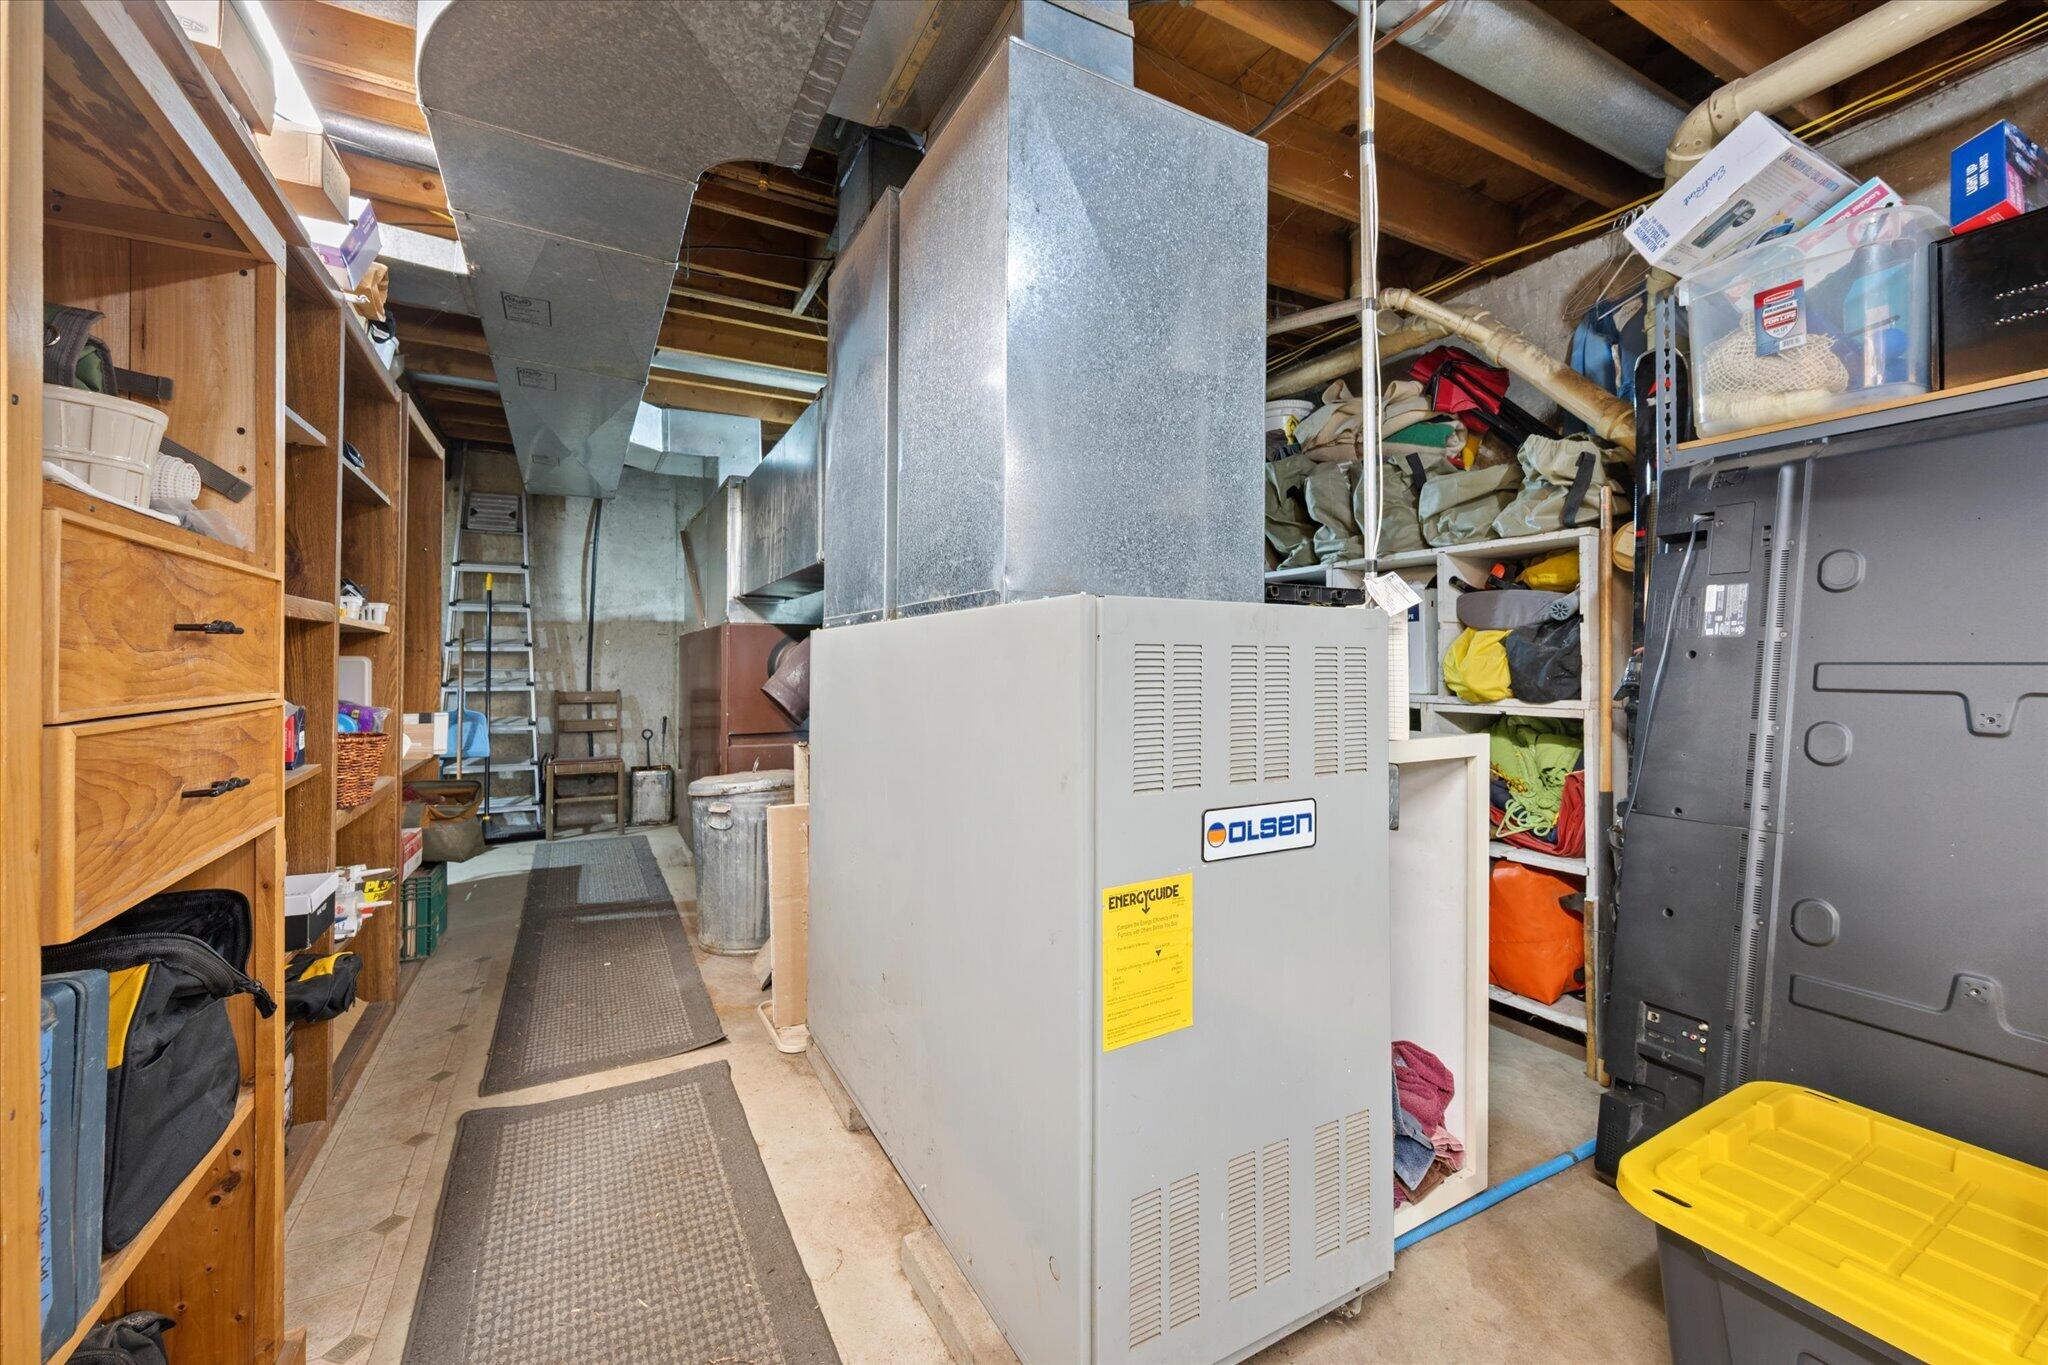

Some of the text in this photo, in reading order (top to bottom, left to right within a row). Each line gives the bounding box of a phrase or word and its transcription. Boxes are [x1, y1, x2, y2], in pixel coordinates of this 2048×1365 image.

[1966, 163, 1978, 196] LIGHT UP
[1979, 153, 1989, 189] LAWN DARTS
[1852, 190, 1881, 213] Ladder
[1634, 226, 1658, 253] BADMINTON
[1640, 217, 1663, 245] VOLLEYBALL
[1228, 812, 1313, 843] OLSEN
[364, 880, 381, 893] PL
[1108, 884, 1179, 911] ENERGYGUIDE
